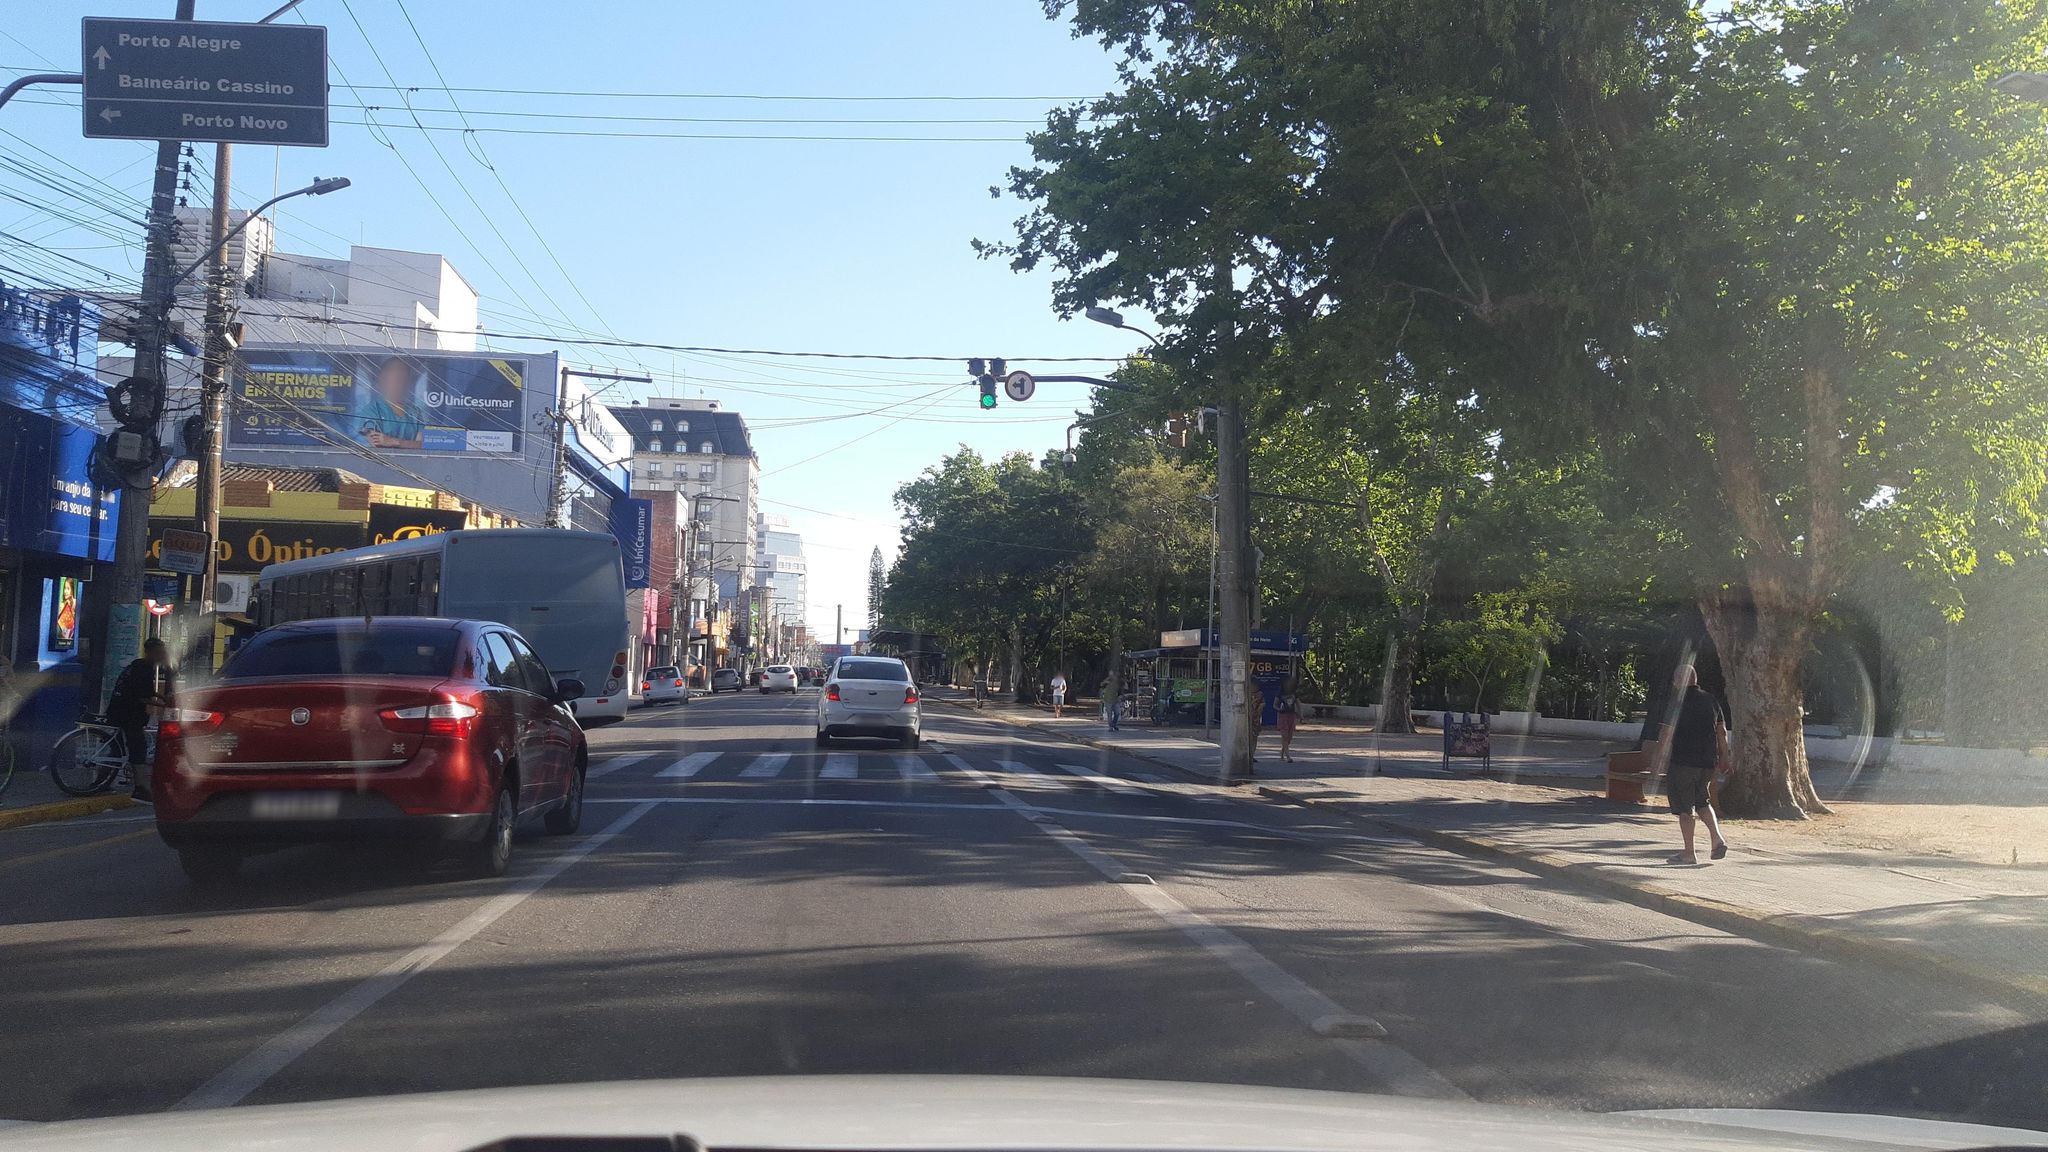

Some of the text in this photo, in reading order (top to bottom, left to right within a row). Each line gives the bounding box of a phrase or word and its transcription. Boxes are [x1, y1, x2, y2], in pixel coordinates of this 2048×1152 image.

[118, 33, 242, 52] Porto Alegre
[118, 74, 295, 96] Balneário Cassino
[181, 112, 289, 131] Porto Novo
[244, 383, 268, 397] EM
[283, 386, 327, 399] ANOS
[444, 394, 515, 408] UniCesumar
[65, 480, 81, 499] anjo
[81, 481, 91, 498] da
[50, 498, 108, 521] para seu cear.
[634, 506, 647, 564] UniCesumar
